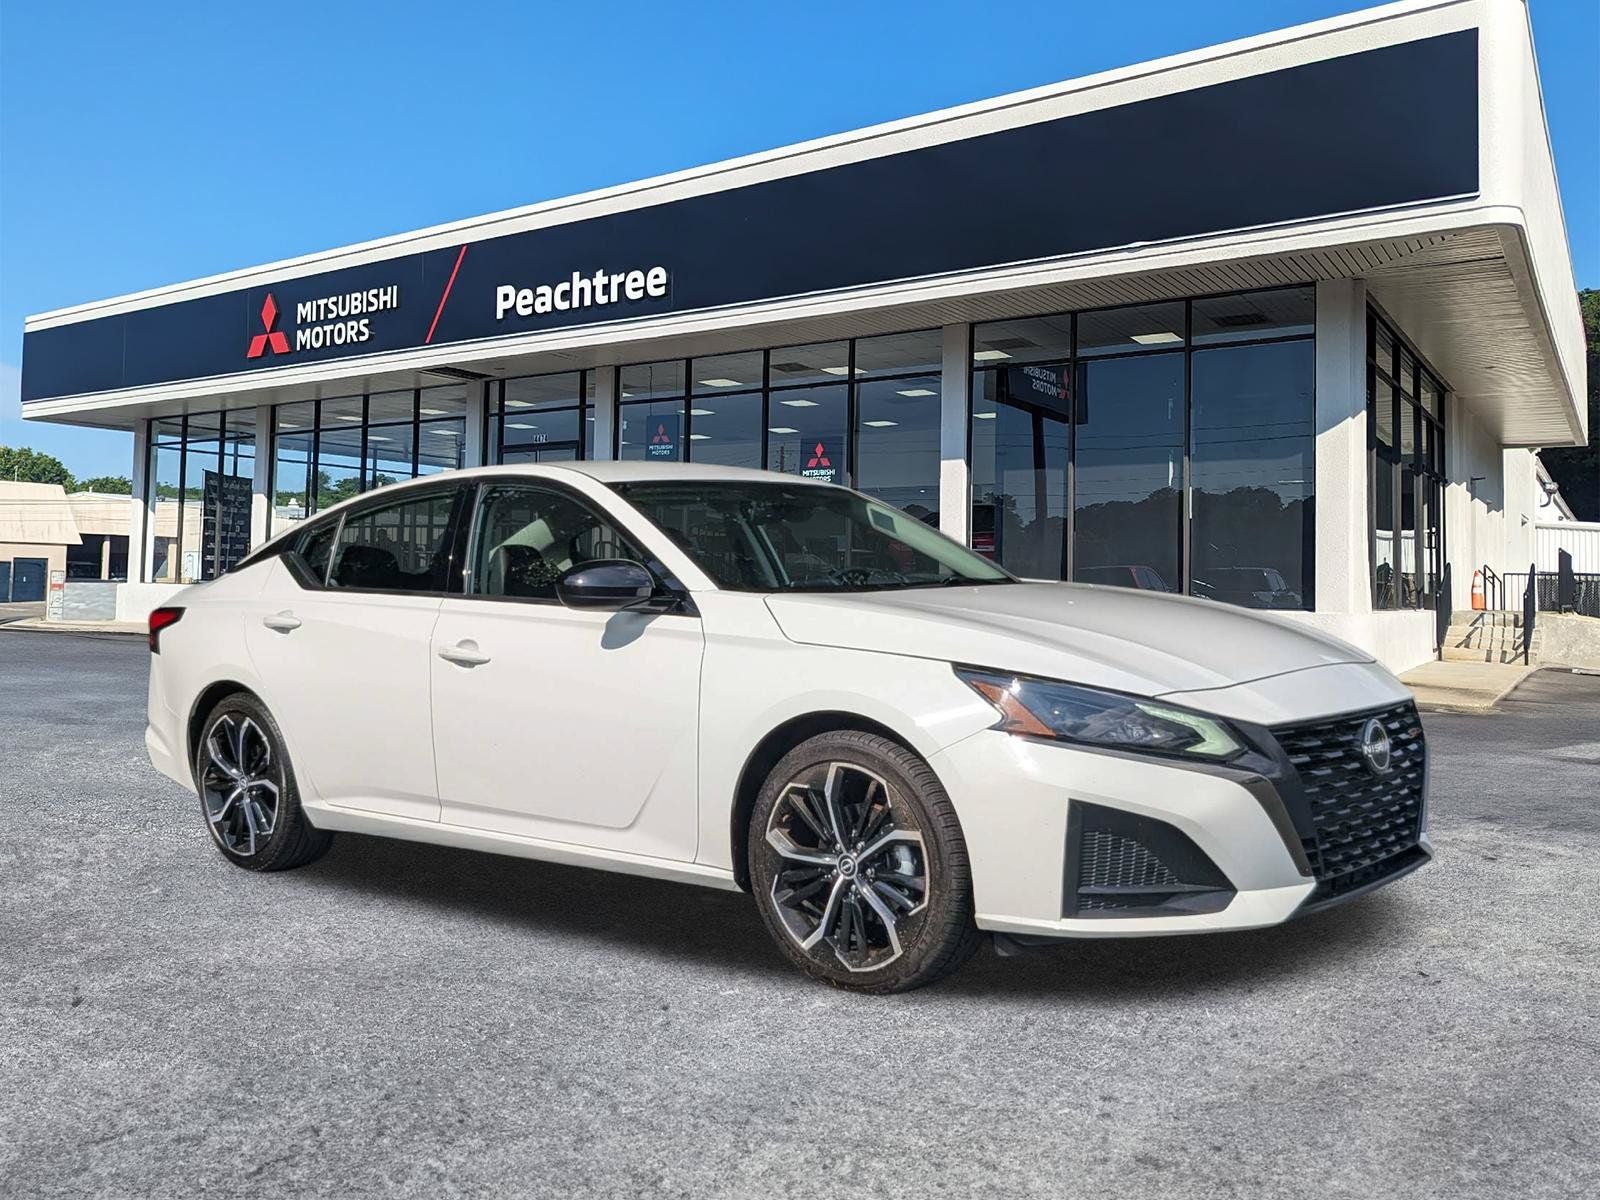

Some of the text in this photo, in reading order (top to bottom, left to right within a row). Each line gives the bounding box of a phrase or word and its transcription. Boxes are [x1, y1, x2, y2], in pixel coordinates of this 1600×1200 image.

[296, 285, 398, 325] MITSUBISHI
[496, 266, 667, 320] Peachtree
[296, 319, 370, 351] MOTORS
[802, 469, 836, 477] MITSUBISHI
